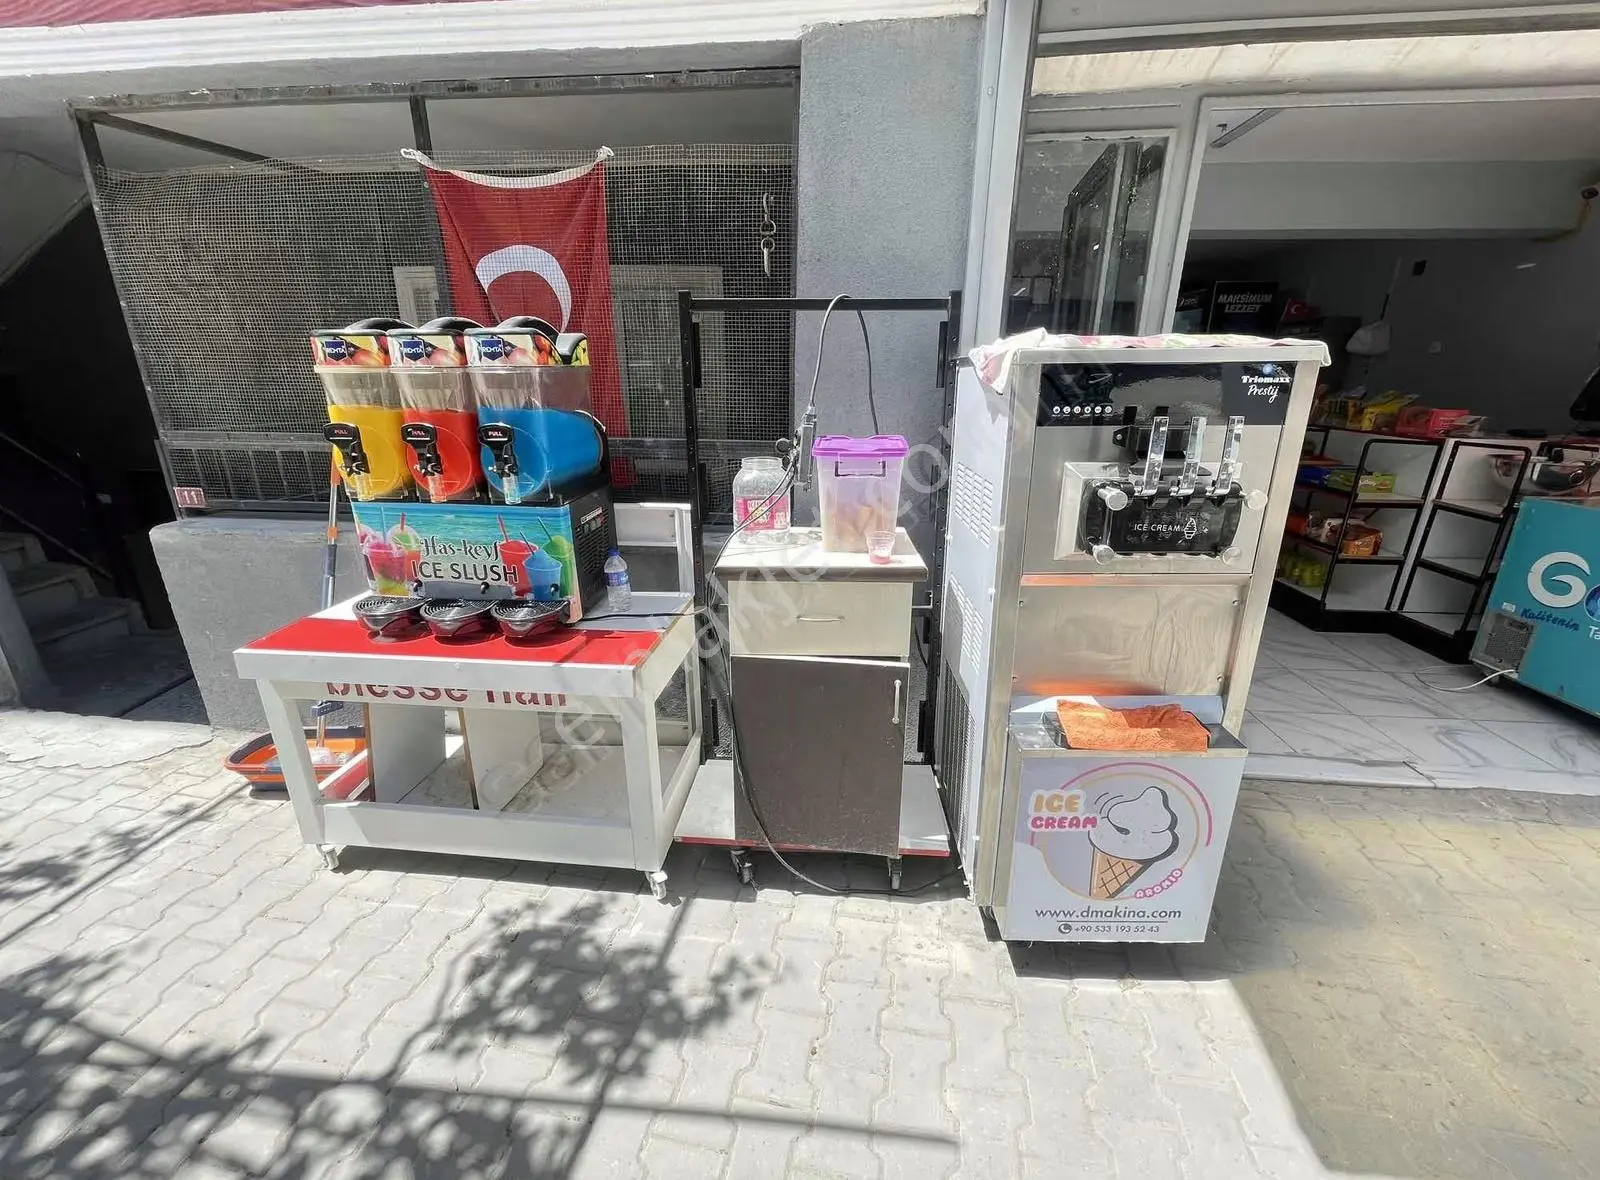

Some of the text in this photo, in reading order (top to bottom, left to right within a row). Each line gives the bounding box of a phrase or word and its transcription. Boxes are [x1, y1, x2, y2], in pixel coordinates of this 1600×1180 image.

[1224, 304, 1262, 313] LEZZET
[1247, 384, 1280, 404] Prestij
[1134, 523, 1181, 532] ICE CREAM
[411, 561, 519, 583] ICE SLUSH
[1034, 793, 1081, 813] ICE
[1031, 816, 1098, 829] CREAM
[1035, 905, 1182, 919] www.dmakina.com
[1074, 925, 1092, 933] +90
[1094, 925, 1112, 933] 533
[1115, 925, 1131, 933] 193
[1134, 925, 1146, 933] 52
